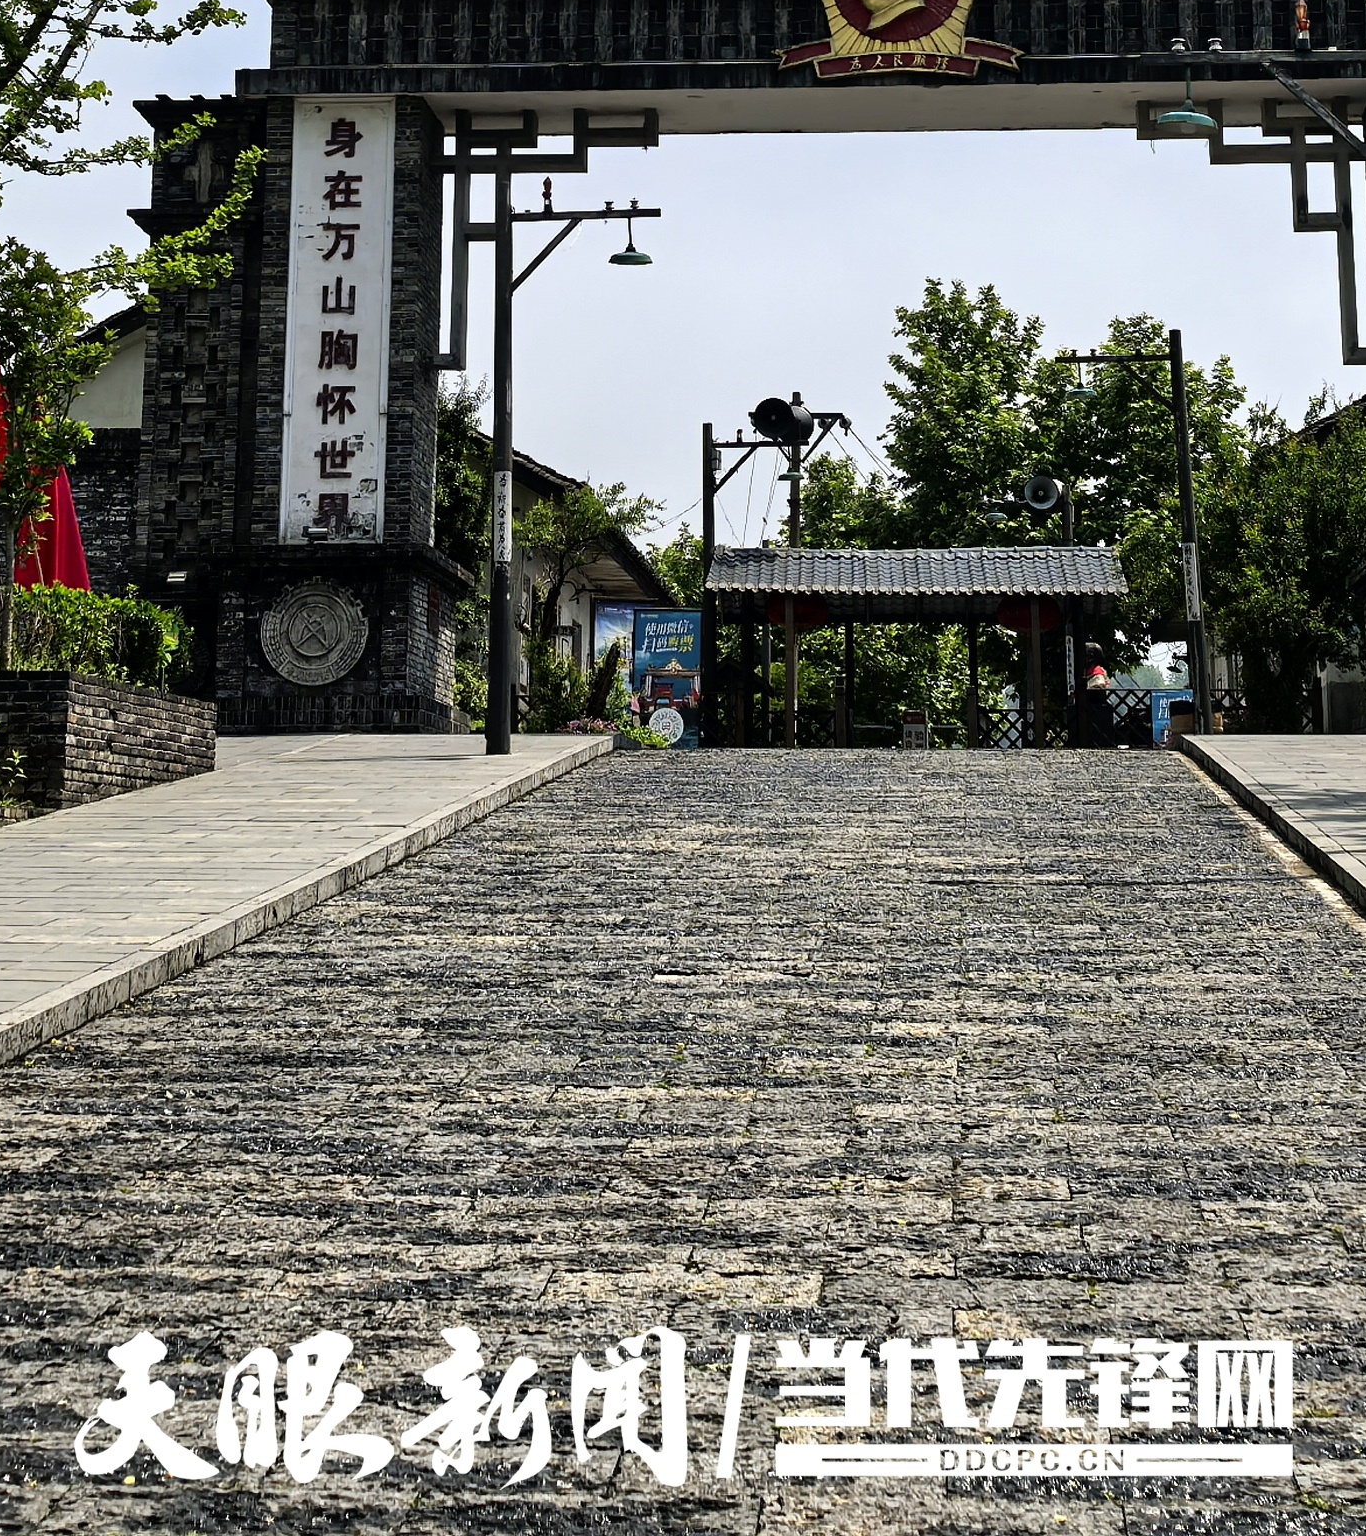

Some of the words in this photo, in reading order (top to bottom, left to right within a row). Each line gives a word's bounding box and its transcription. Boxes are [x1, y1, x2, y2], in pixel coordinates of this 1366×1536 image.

[314, 117, 365, 530] 身在万山胸怀世界
